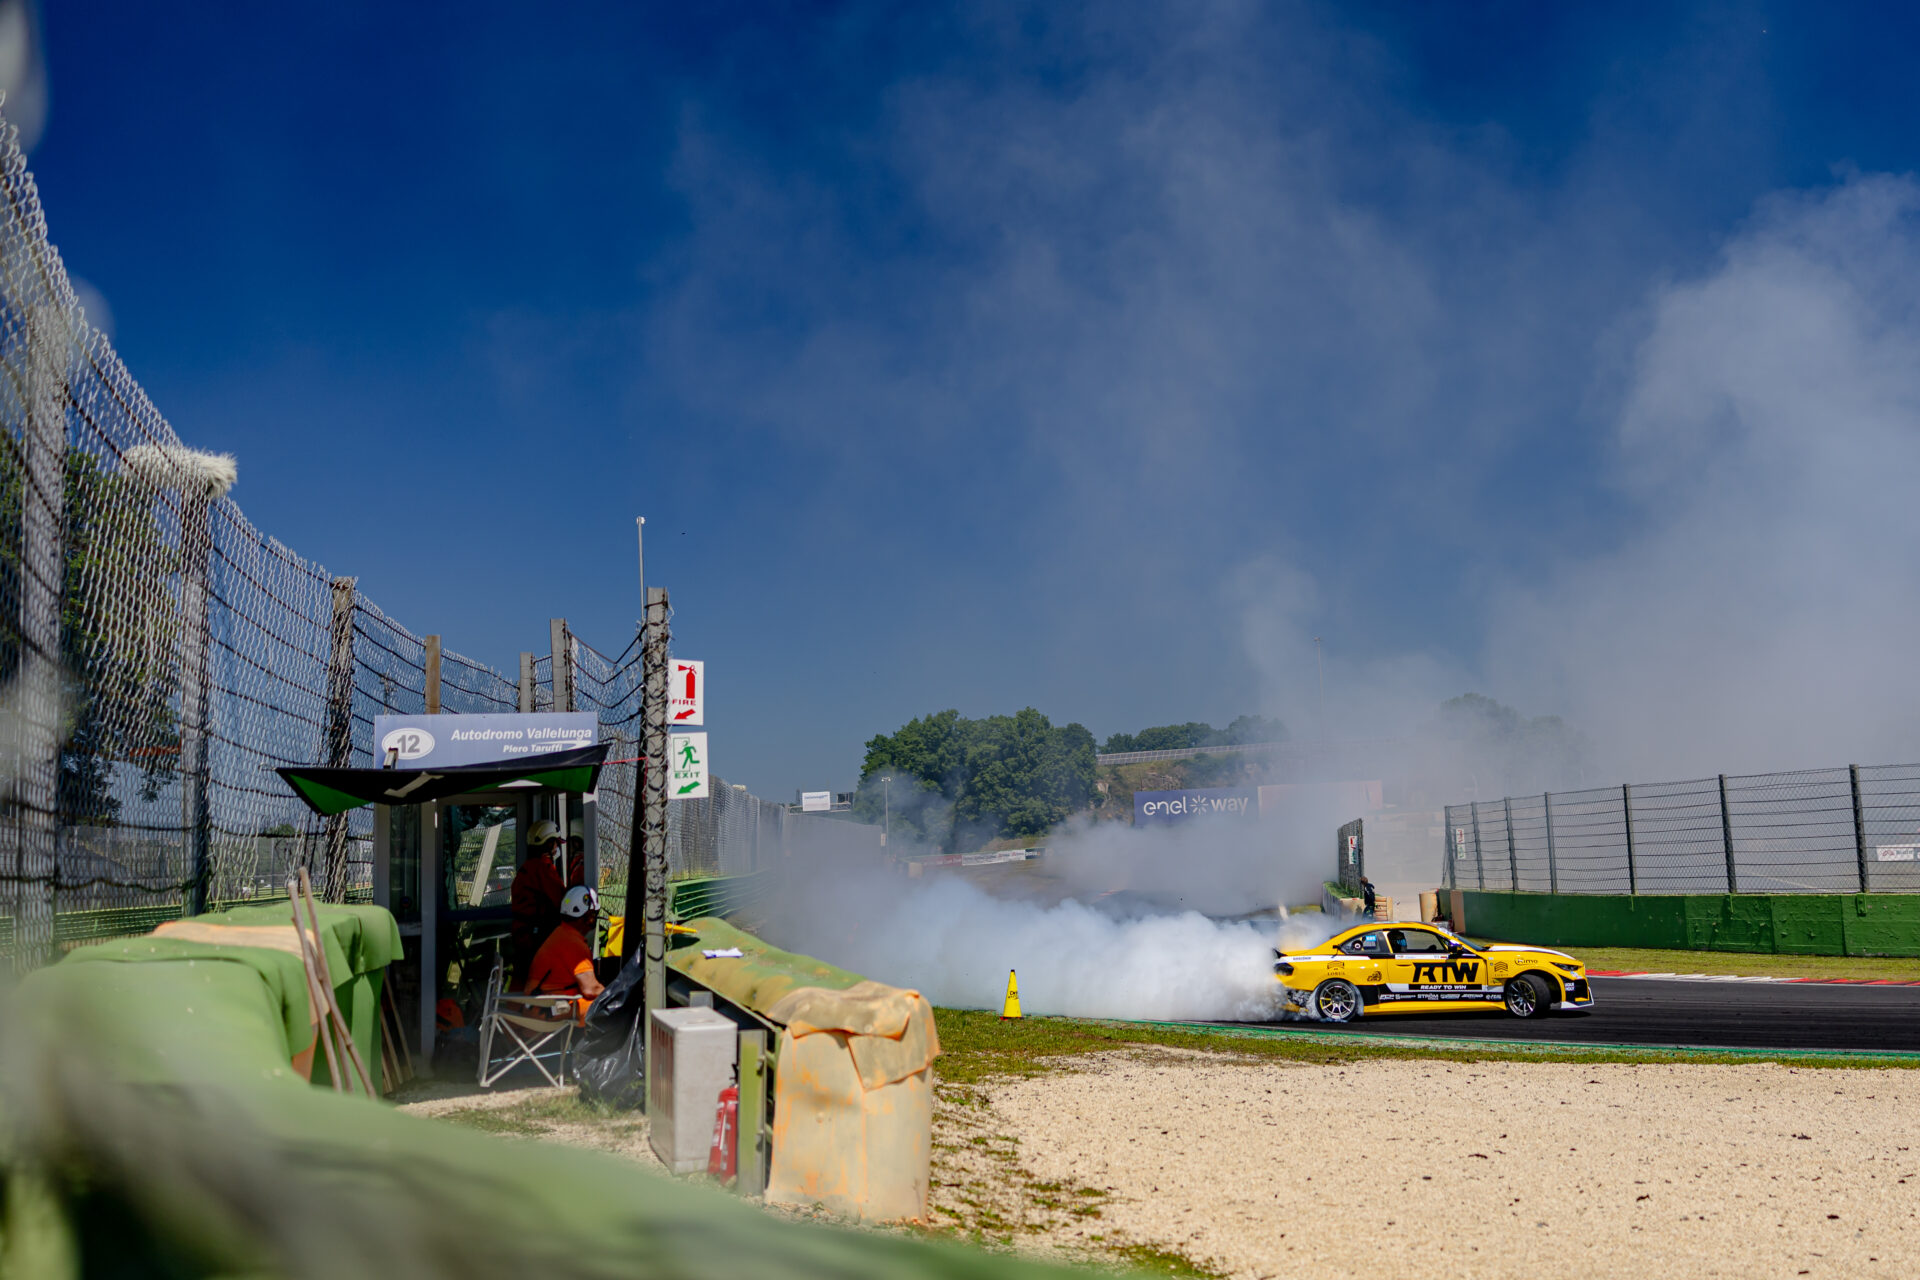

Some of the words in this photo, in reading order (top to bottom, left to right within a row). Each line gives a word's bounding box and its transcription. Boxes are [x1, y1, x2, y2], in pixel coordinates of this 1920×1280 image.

[451, 729, 523, 741] Autodromo
[527, 727, 592, 739] Vallelunga
[397, 734, 420, 753] 12
[502, 744, 529, 753] Piero
[531, 743, 563, 753] Taruffi
[674, 771, 700, 779] EXIT
[1143, 795, 1188, 816] enel
[1210, 797, 1249, 817] way
[1412, 962, 1479, 982] RTW
